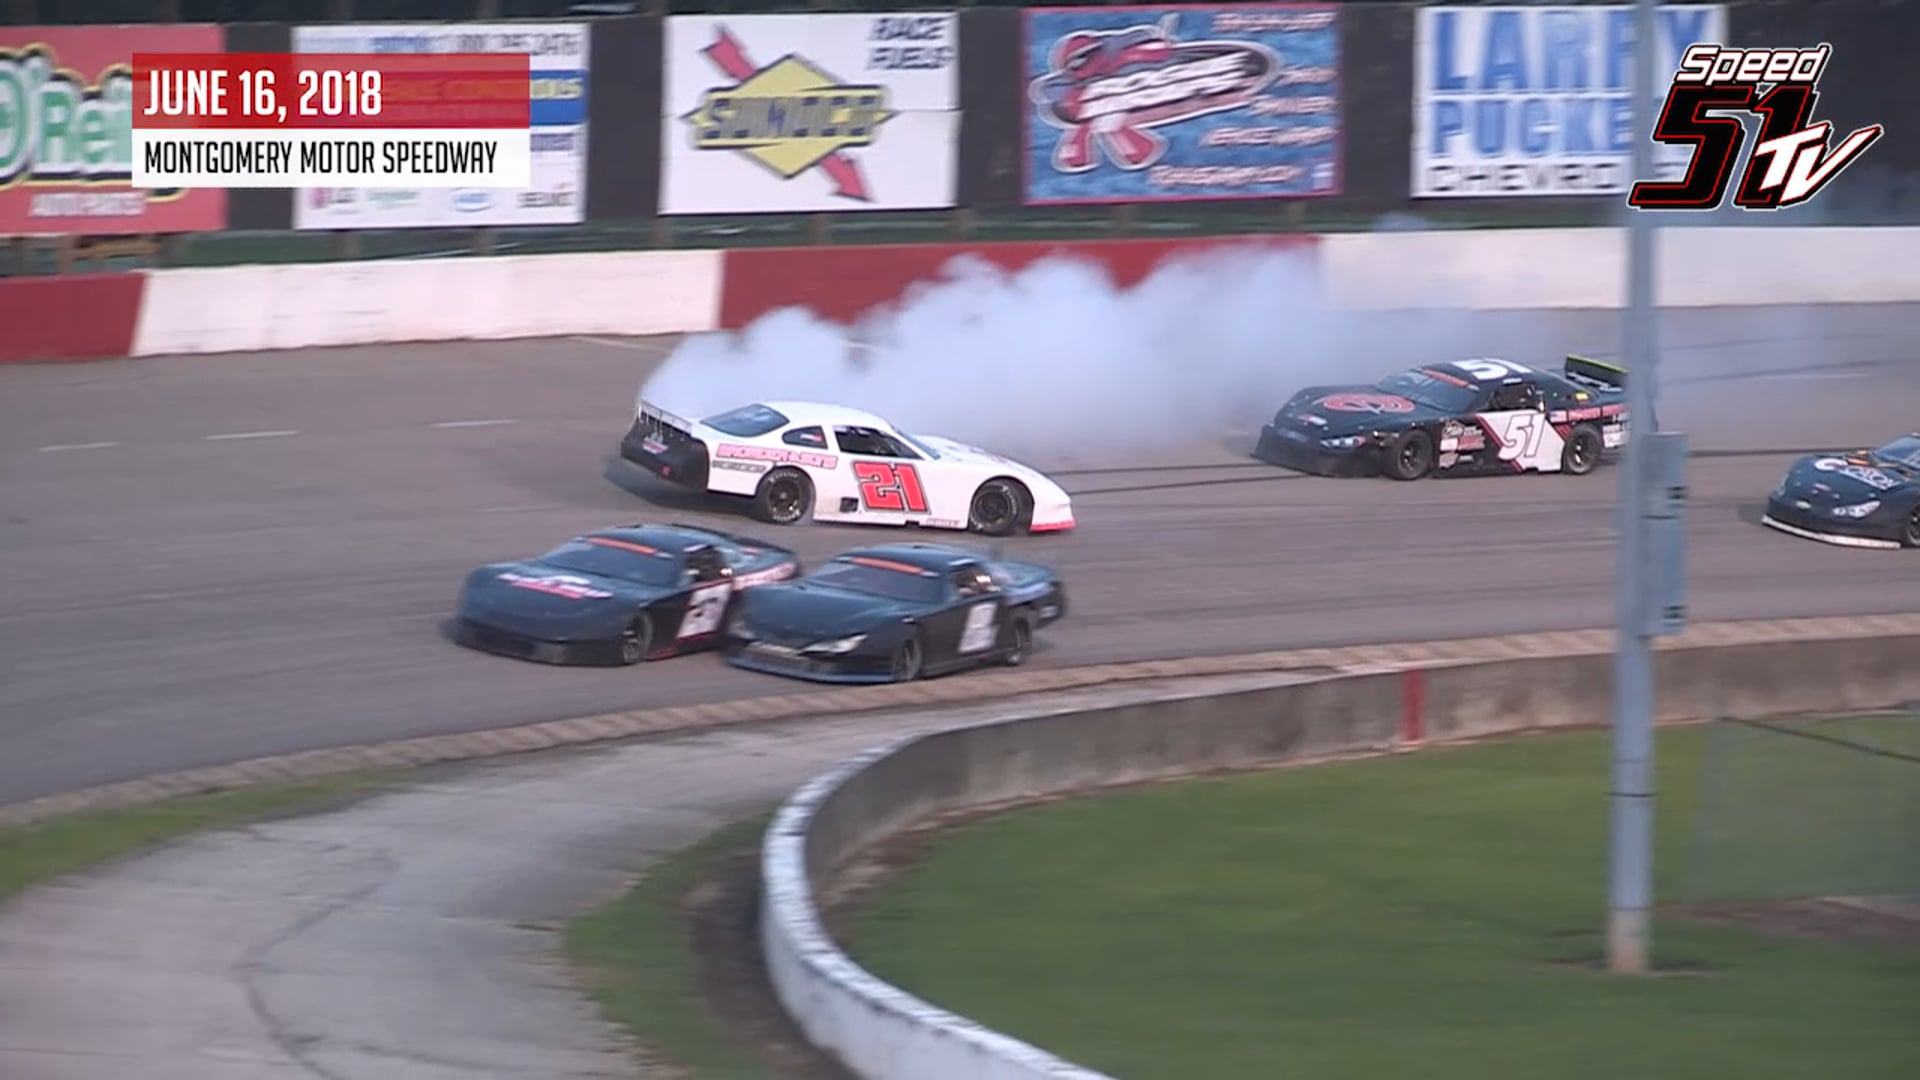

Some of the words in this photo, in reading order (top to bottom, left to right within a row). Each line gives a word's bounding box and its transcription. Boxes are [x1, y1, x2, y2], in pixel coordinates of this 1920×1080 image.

[870, 17, 950, 40] RACE
[866, 47, 955, 70] FUELS
[700, 96, 882, 140] SUNOCO
[1434, 100, 1642, 154] PUCKE
[1428, 162, 1640, 192] CHEVRO
[1451, 358, 1534, 380] 51
[1496, 413, 1546, 460] 51
[851, 459, 931, 514] 21
